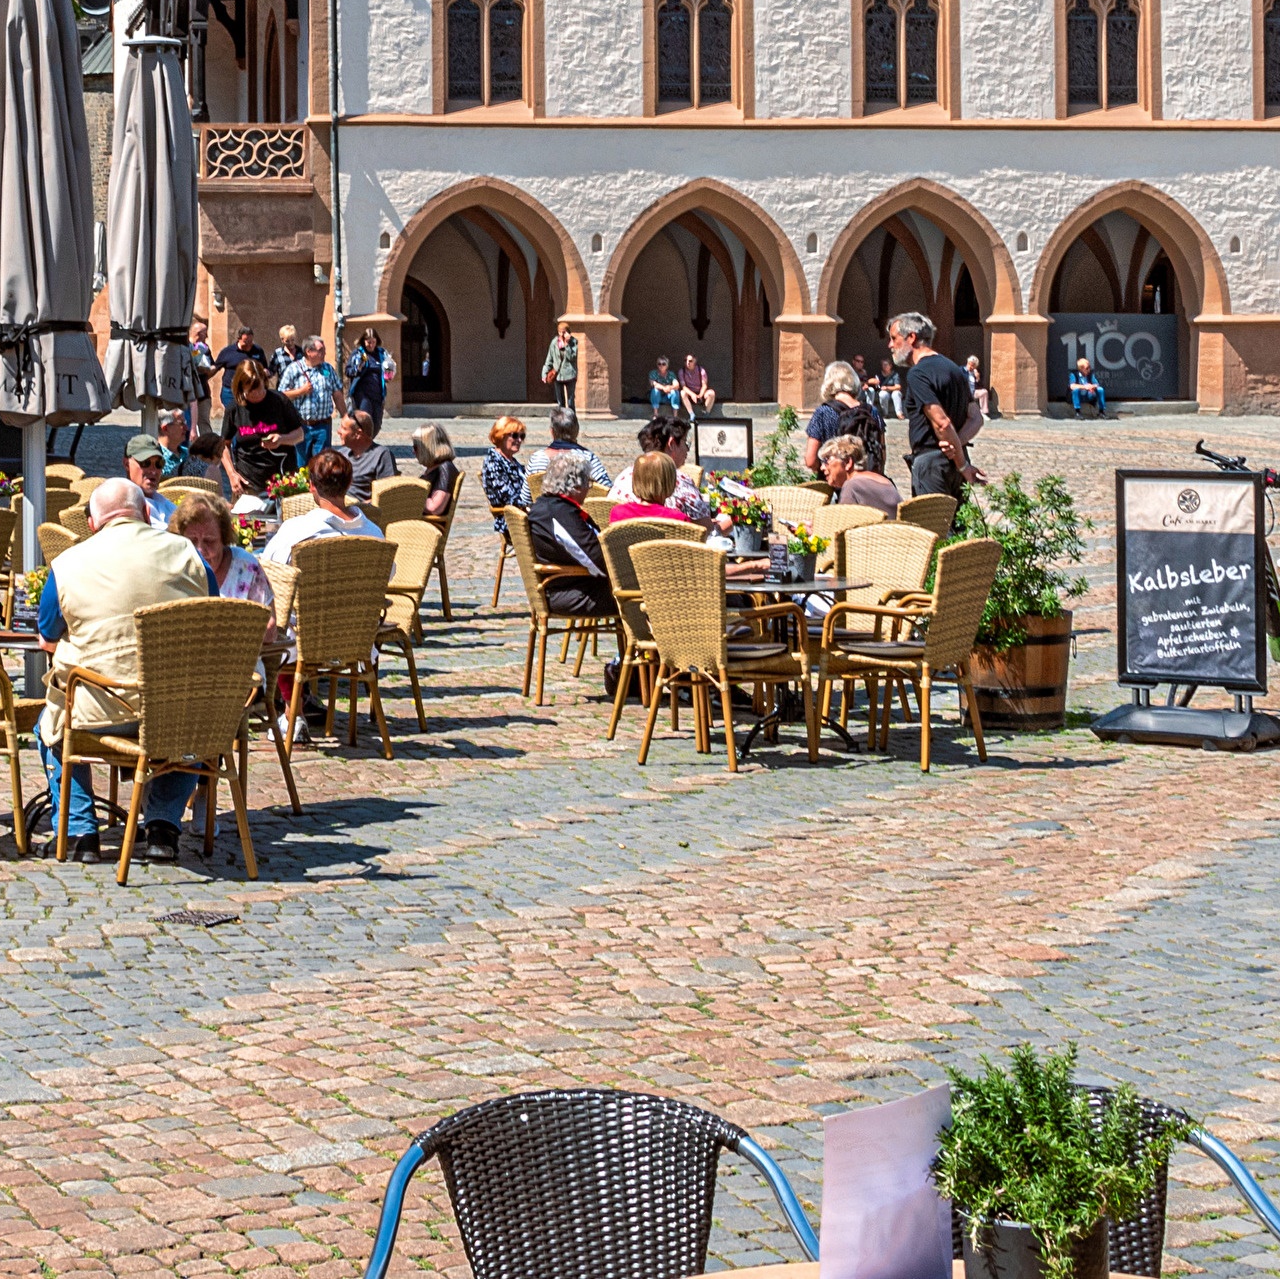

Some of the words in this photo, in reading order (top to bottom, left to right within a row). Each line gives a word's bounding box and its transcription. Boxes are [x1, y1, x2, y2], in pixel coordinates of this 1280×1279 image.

[1128, 558, 1252, 594] Kalbsleber
[1141, 609, 1199, 627] gebratenen
[1200, 601, 1251, 616] Zwiebeln,
[1170, 617, 1223, 633] sautierten
[1156, 639, 1242, 659] Butterkartoffeln
